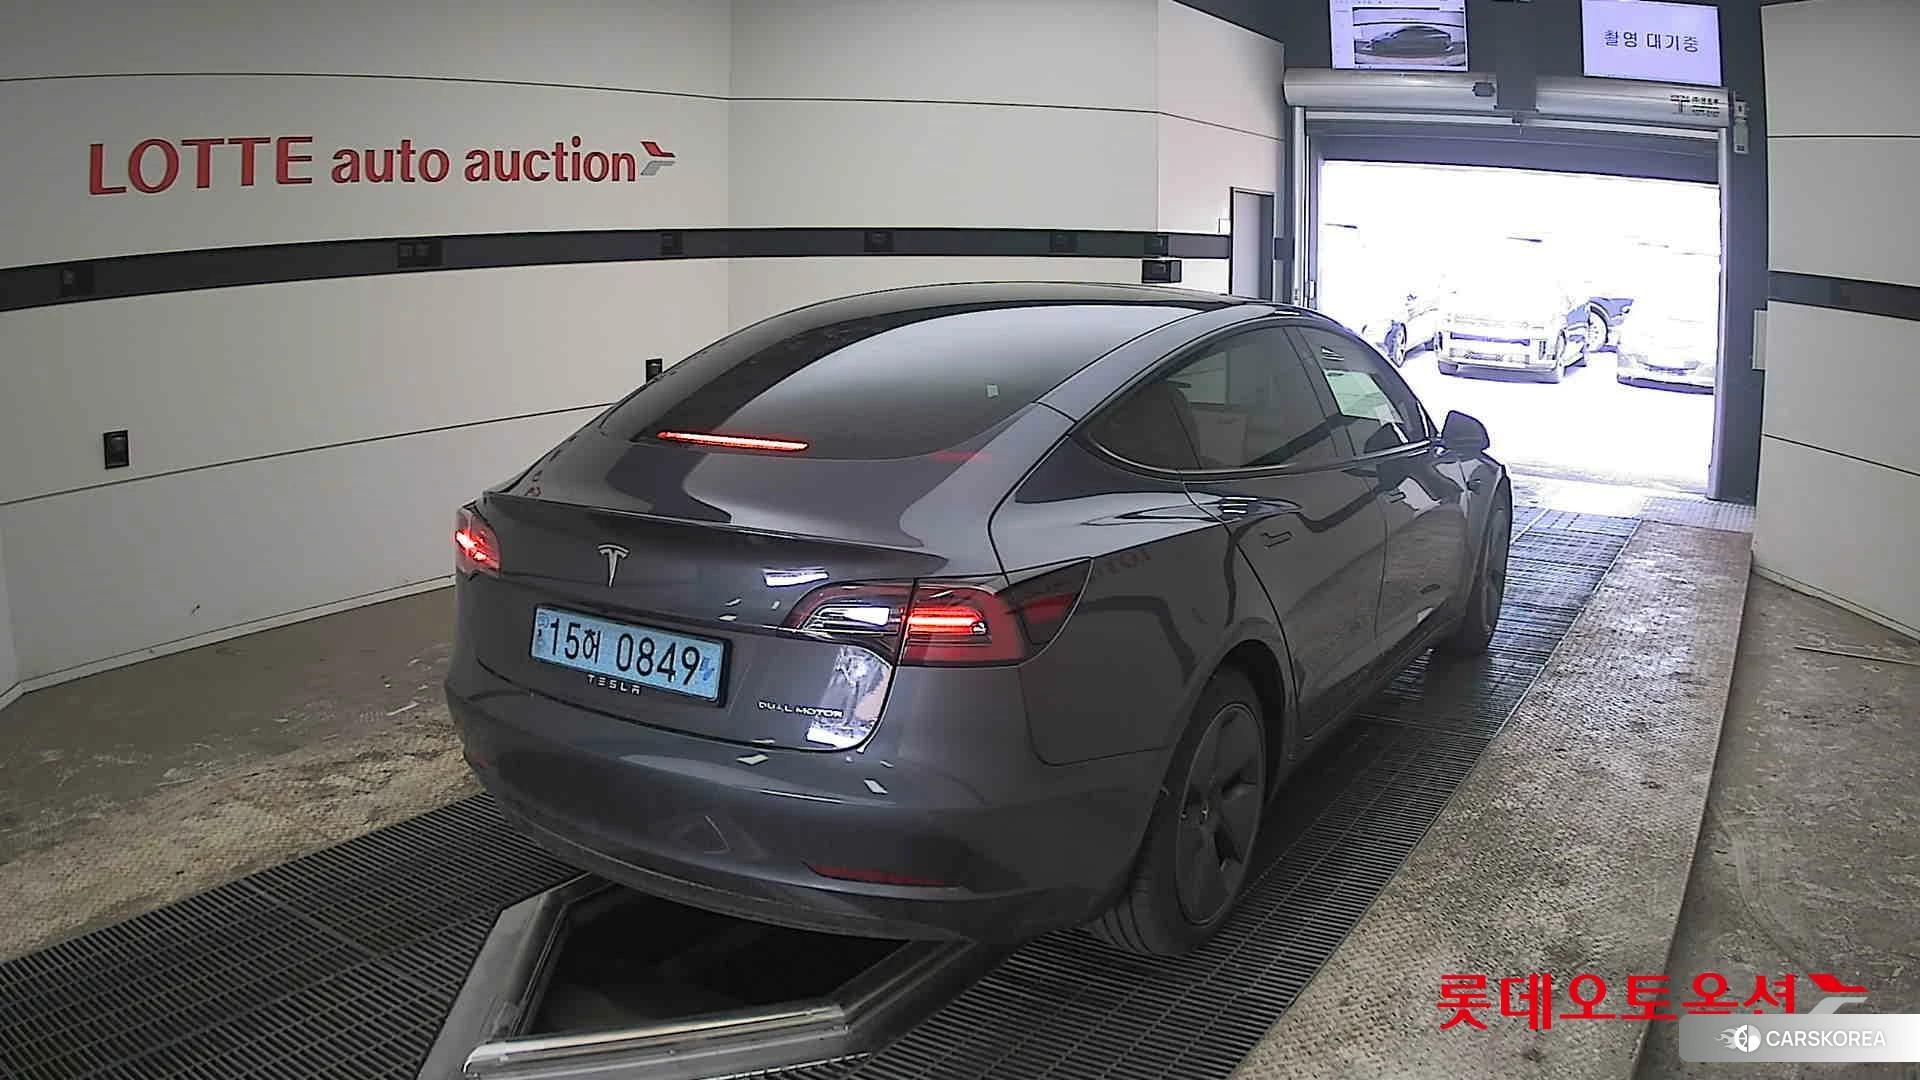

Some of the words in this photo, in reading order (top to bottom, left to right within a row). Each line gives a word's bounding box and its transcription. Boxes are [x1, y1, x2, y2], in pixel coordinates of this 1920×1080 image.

[1646, 33, 1699, 53] 대기중
[89, 136, 313, 195] LOTTE
[331, 139, 450, 184] auto
[464, 135, 637, 183] auction
[550, 617, 601, 664] 15허
[615, 632, 701, 686] 0849
[586, 674, 641, 695] TESLA
[794, 706, 844, 719] MOTOR
